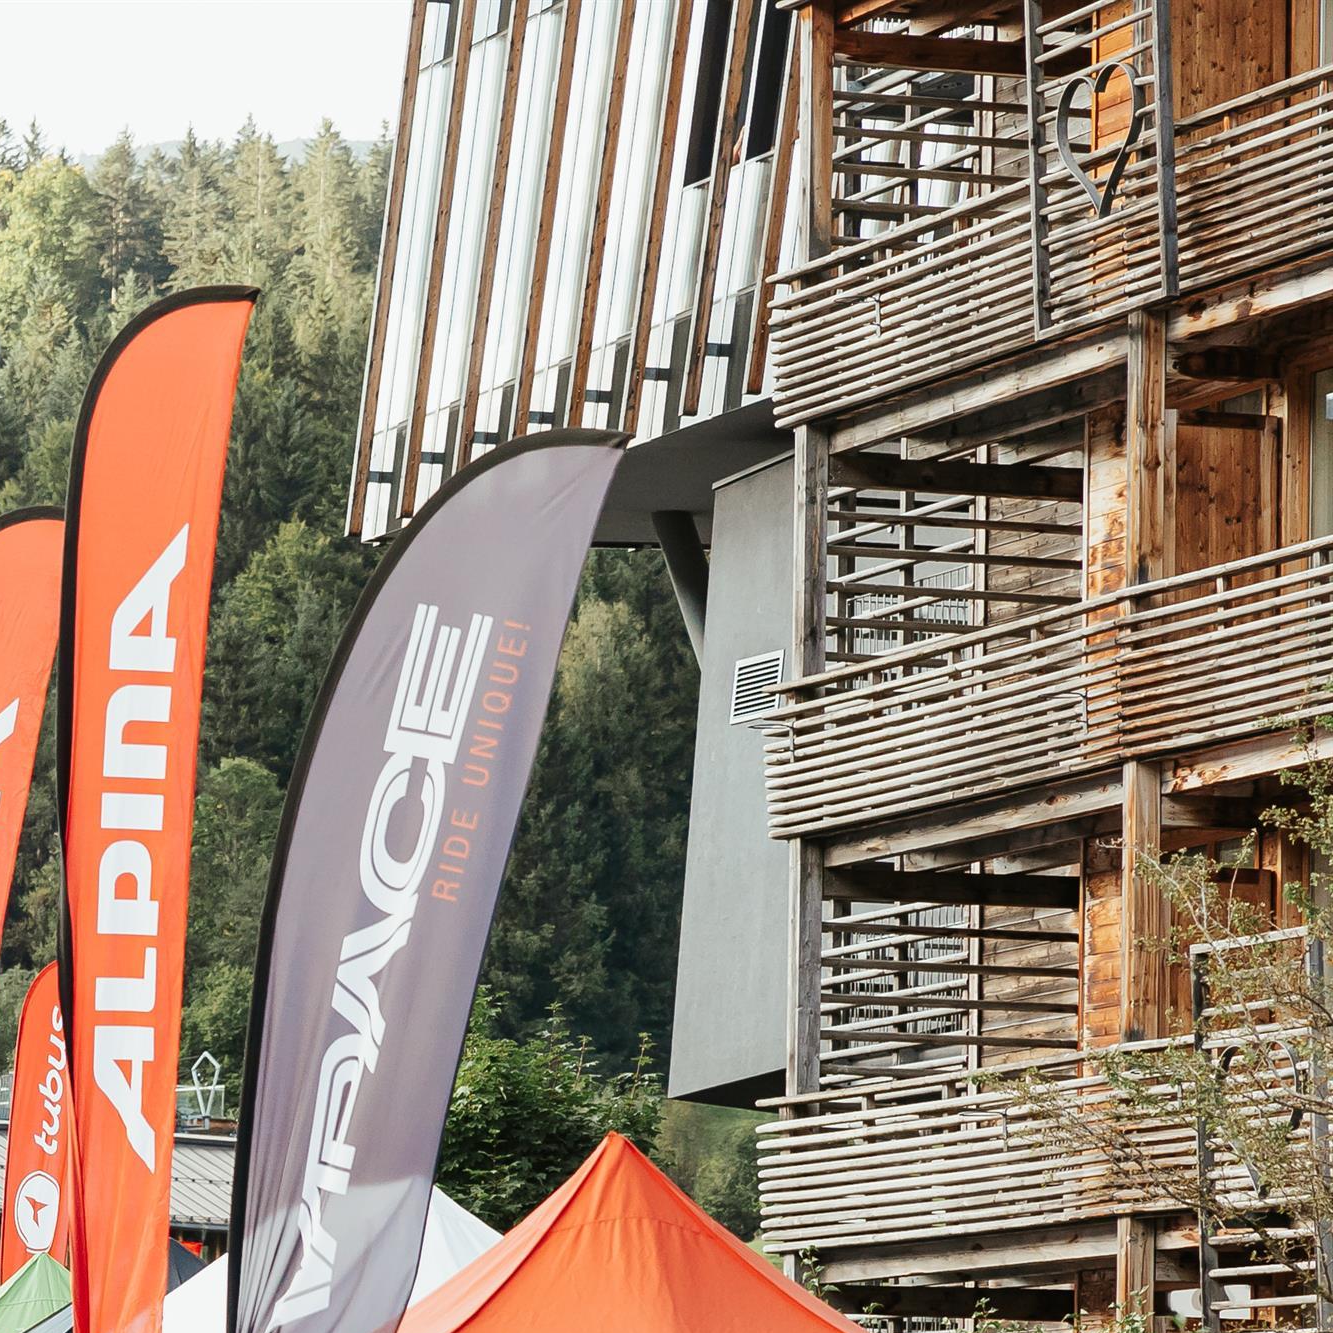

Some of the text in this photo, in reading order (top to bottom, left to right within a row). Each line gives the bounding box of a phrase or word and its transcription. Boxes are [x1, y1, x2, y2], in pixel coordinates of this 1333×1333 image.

[92, 522, 190, 1174] ALPINA
[432, 617, 532, 904] RIDE UNIQUE!
[34, 1004, 67, 1155] tubus
